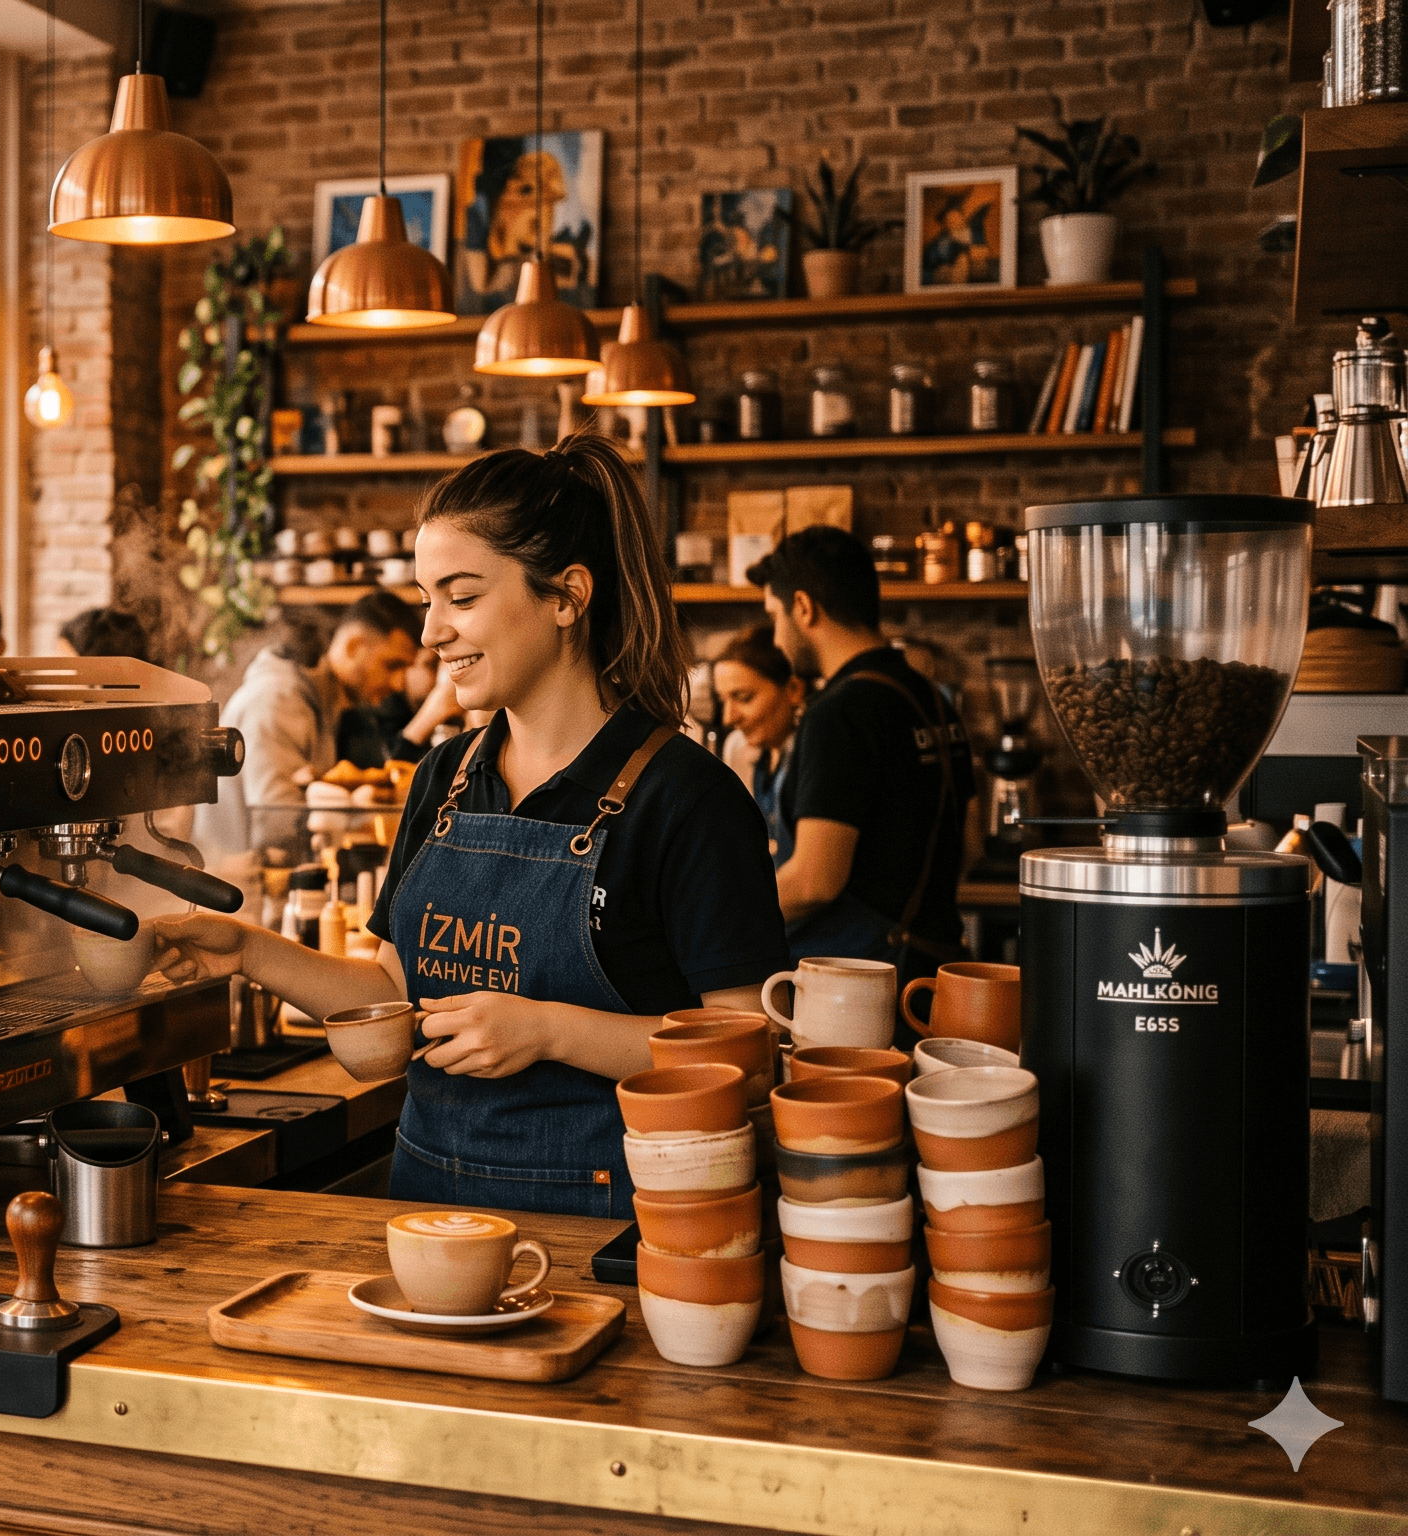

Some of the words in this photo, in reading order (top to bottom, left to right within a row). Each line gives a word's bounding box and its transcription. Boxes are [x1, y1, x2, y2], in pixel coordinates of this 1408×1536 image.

[419, 902, 521, 965] İZMİR
[417, 956, 483, 986] KAHVE
[488, 966, 520, 993] EVİ
[1097, 981, 1219, 1000] MAHLKÖNIG
[1134, 1016, 1180, 1032] E65S
